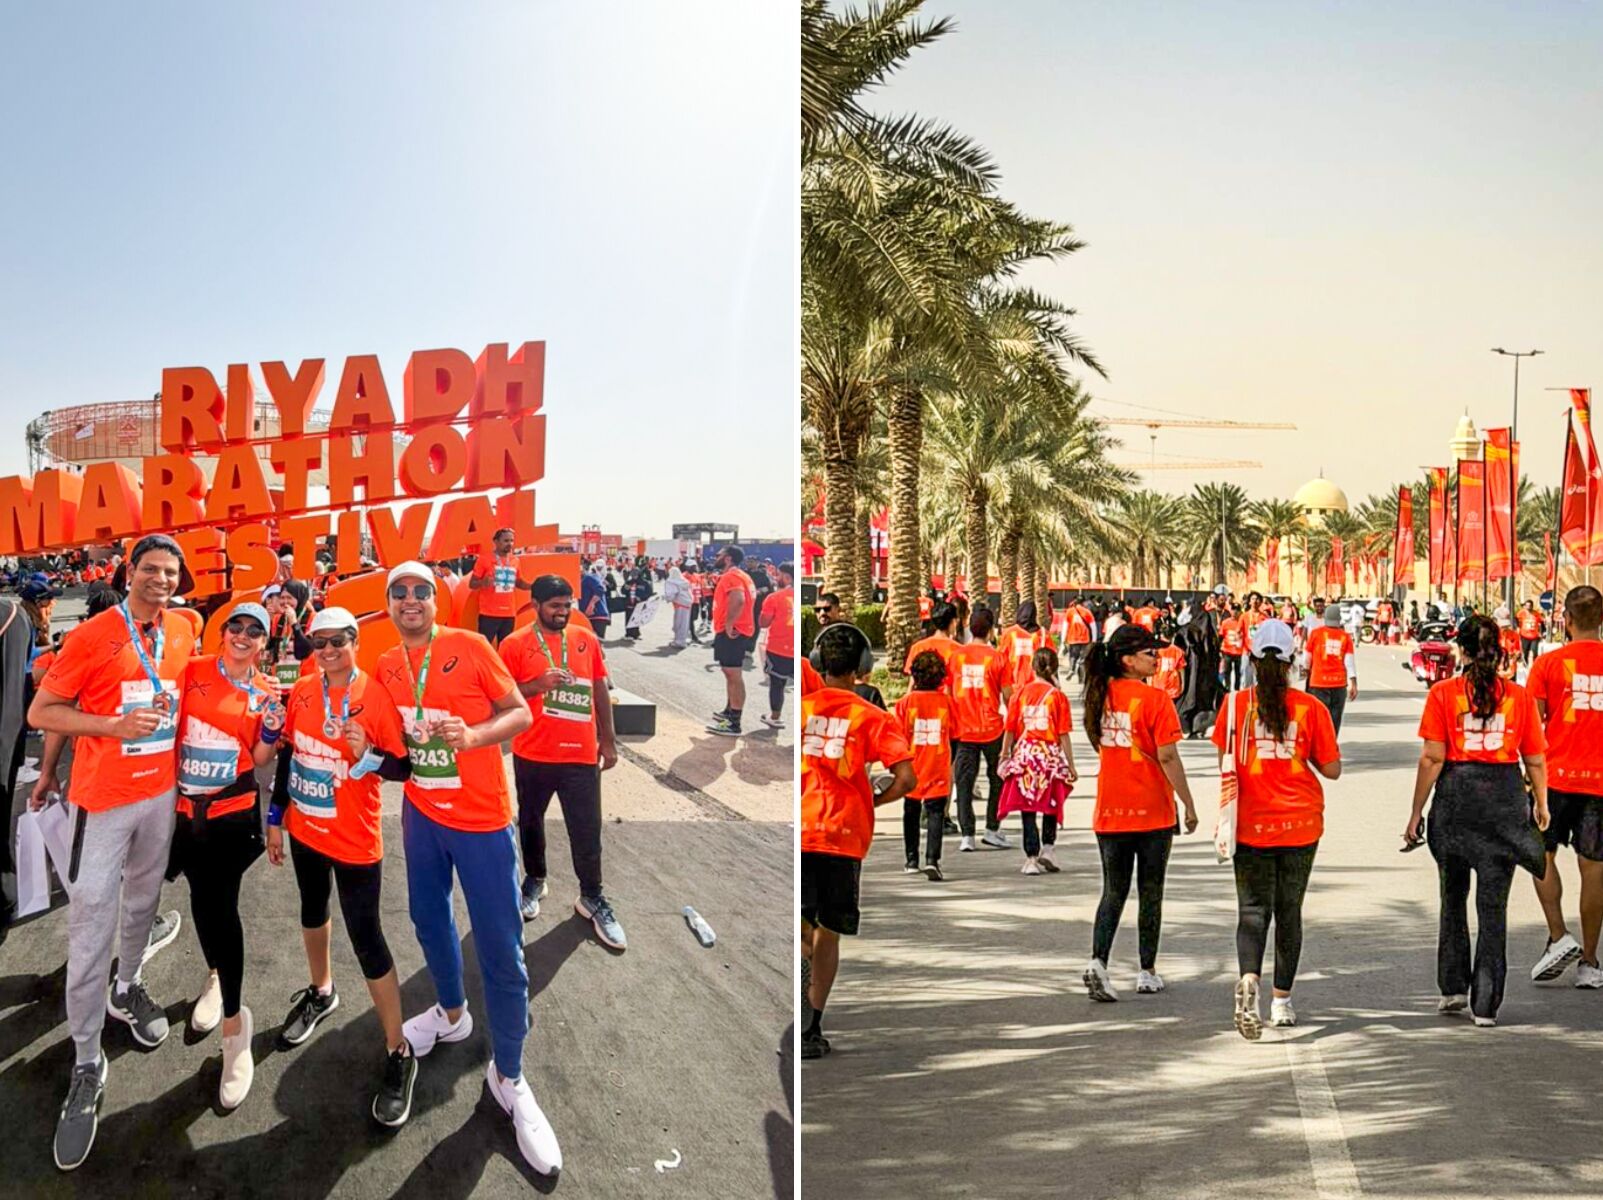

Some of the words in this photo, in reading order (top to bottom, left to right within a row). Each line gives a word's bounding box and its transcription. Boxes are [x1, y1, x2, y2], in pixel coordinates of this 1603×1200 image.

[161, 340, 547, 455] RIYADH
[0, 413, 547, 556] MARATHON
[126, 489, 560, 599] ESTIVAL
[551, 689, 590, 707] 18382
[801, 735, 846, 759] 26
[1256, 739, 1297, 760] 26
[1463, 731, 1505, 751] 26
[182, 758, 231, 778] 48977
[290, 772, 329, 799] 51950
